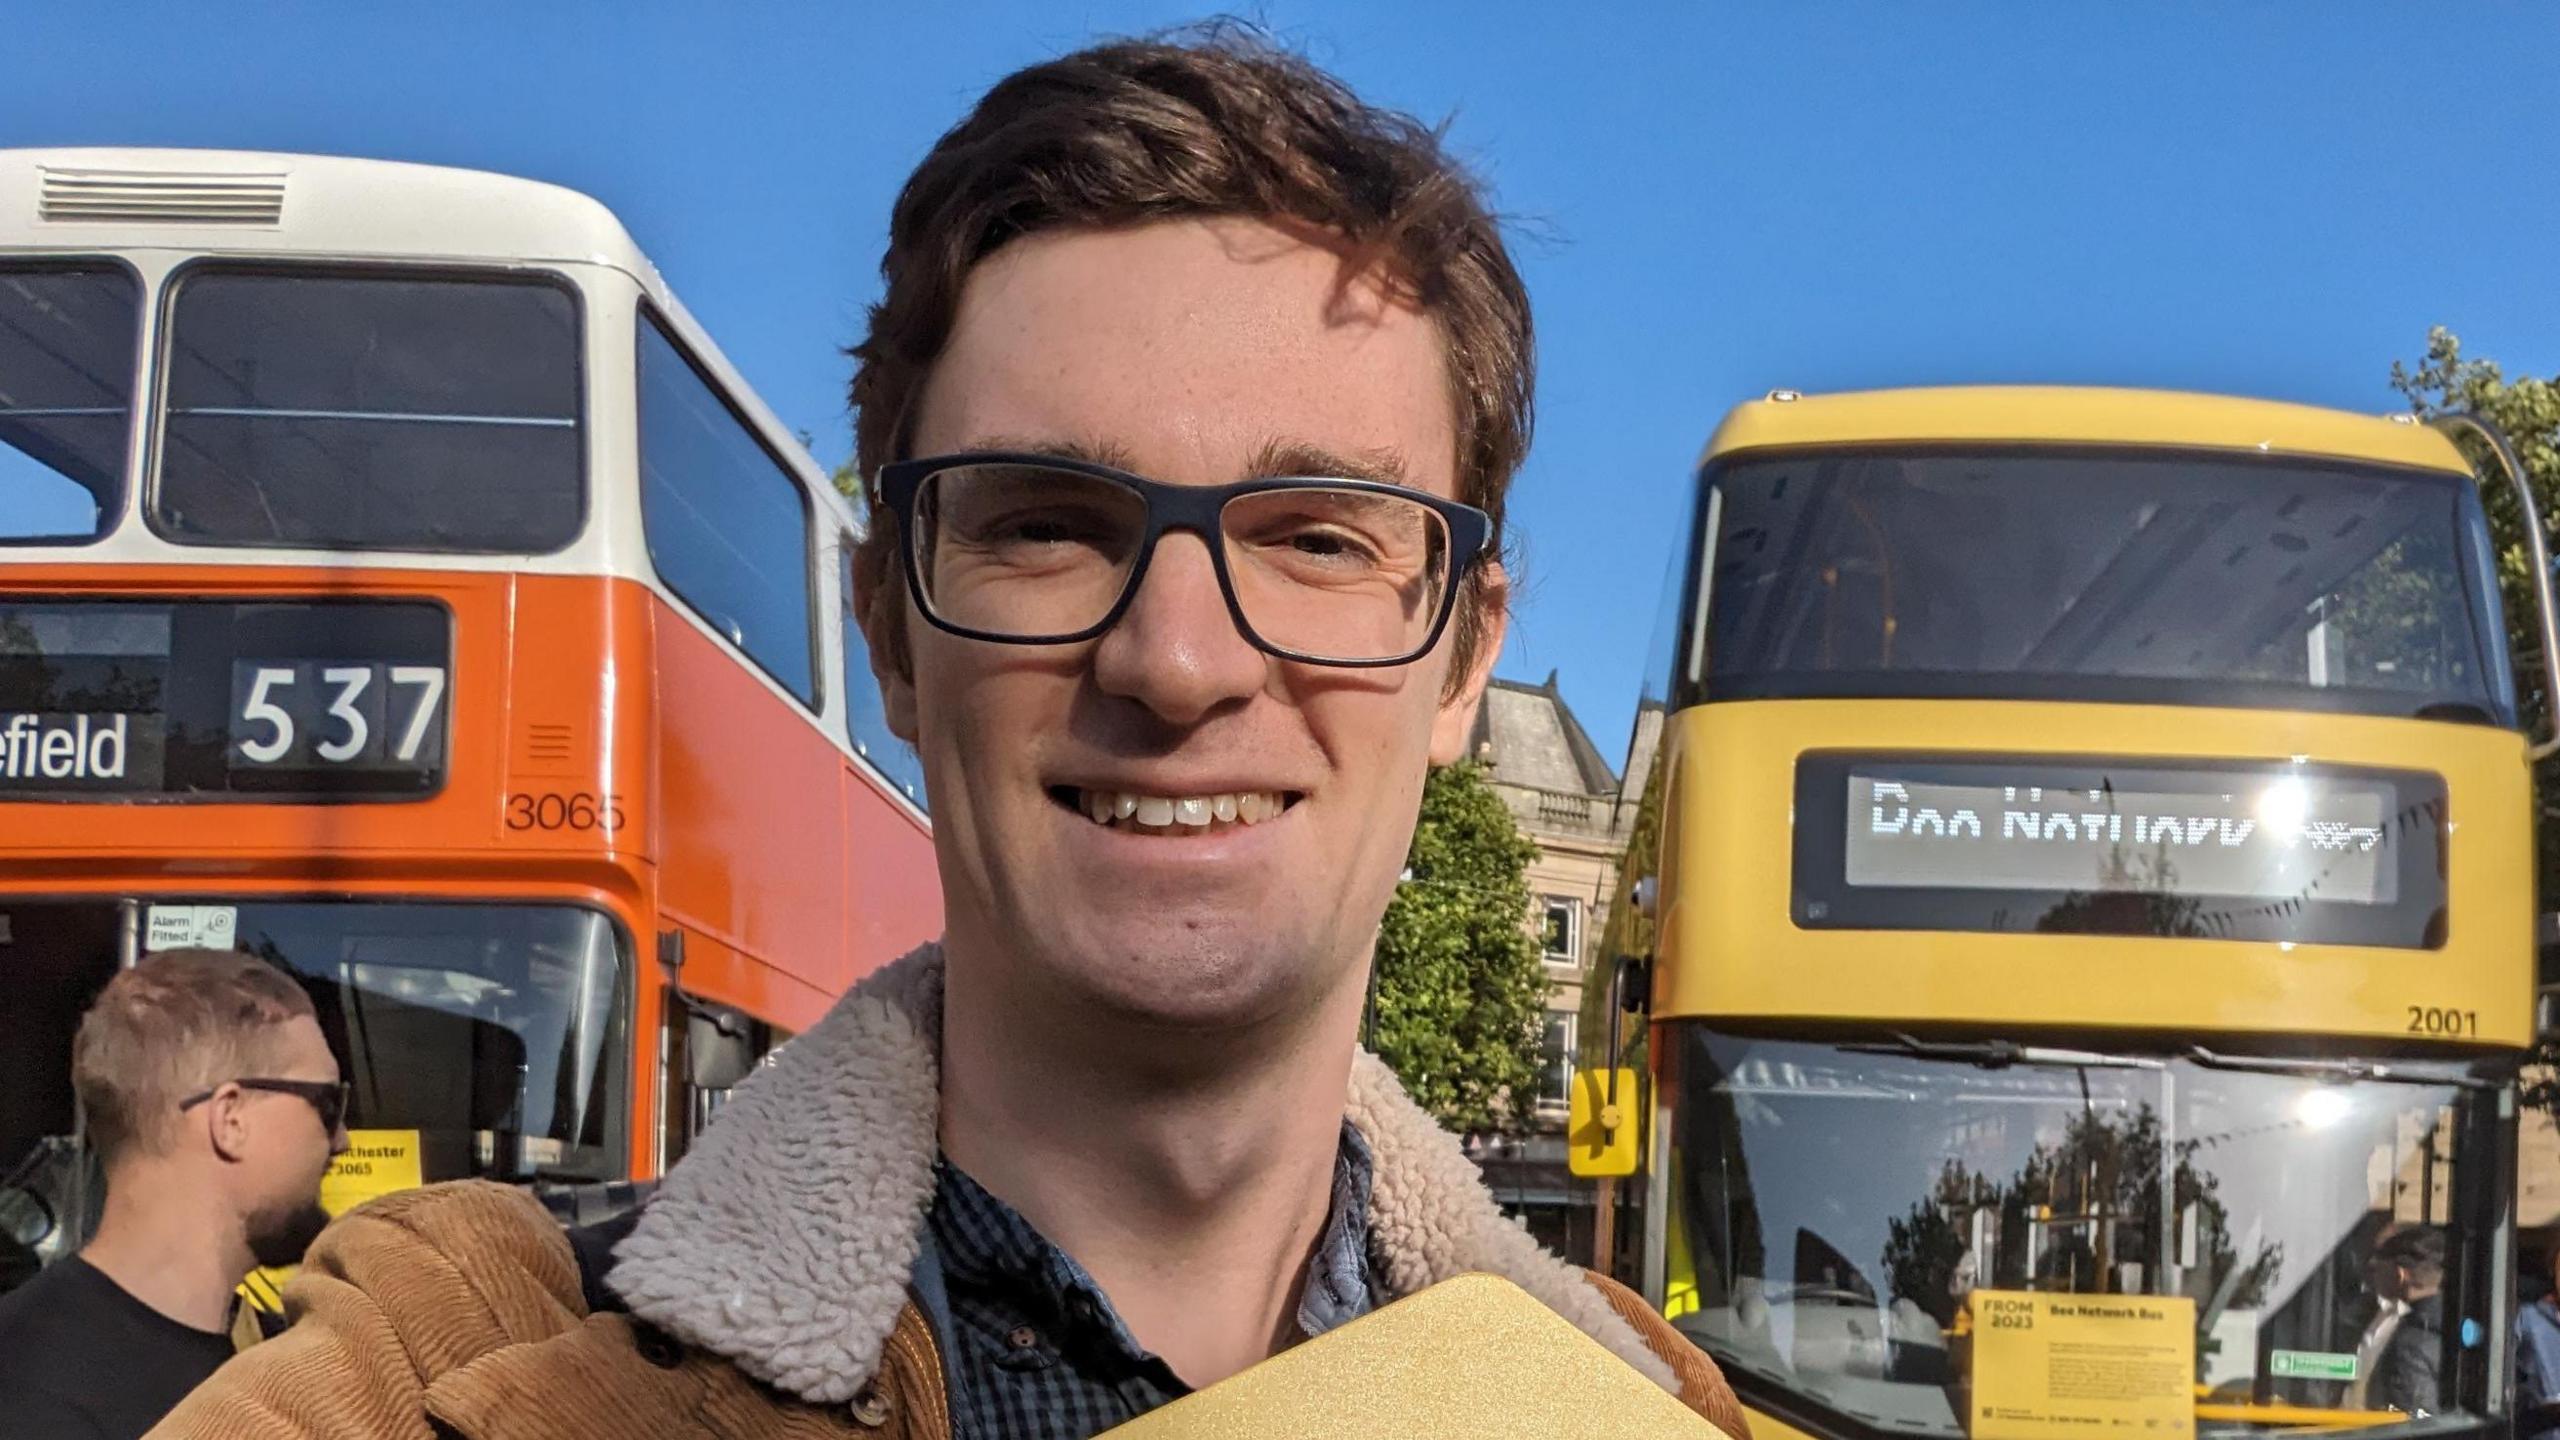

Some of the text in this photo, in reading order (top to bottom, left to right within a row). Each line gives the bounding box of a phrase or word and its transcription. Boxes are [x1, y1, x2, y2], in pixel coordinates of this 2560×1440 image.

[240, 667, 444, 762] 537
[0, 713, 126, 778] field
[506, 792, 625, 831] 3065
[153, 916, 190, 927] Alarm
[152, 930, 189, 942] Fitted
[2407, 1005, 2476, 1039] 2001
[1984, 1300, 2034, 1313] FROM
[2050, 1305, 2164, 1320] Bee Network Bus
[1991, 1315, 2034, 1328] 2023
